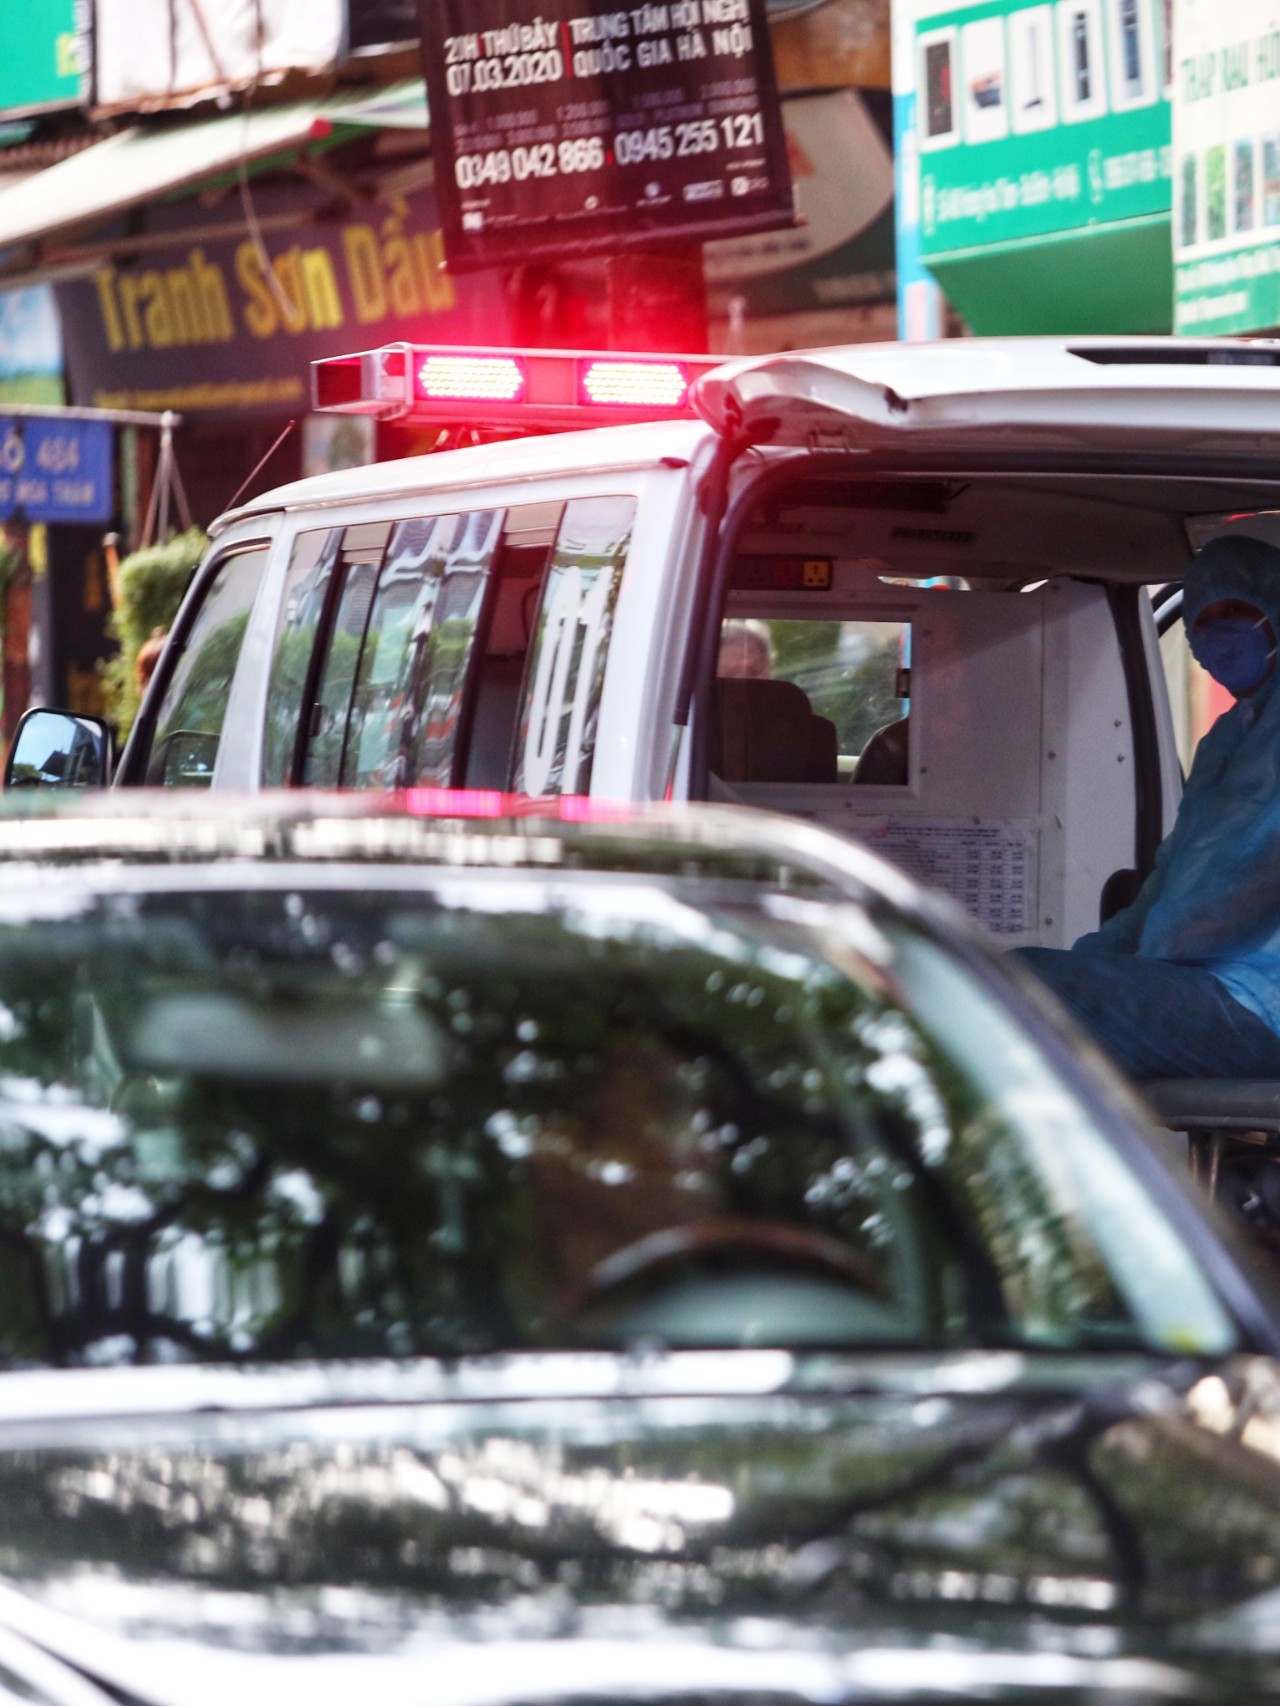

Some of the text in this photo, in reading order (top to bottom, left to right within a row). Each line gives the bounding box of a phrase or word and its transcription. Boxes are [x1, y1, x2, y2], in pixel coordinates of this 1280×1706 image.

[567, 11, 630, 46] TRUNG
[446, 49, 563, 96] 07.03.2020
[573, 39, 632, 78] QUỐC
[637, 36, 673, 68] GIA
[511, 143, 557, 181] 042
[557, 136, 604, 175] 866
[614, 126, 675, 166] 0945
[675, 118, 720, 157] 255
[721, 112, 765, 149] 121
[93, 249, 234, 352] Tranh
[235, 241, 344, 340] Sơn
